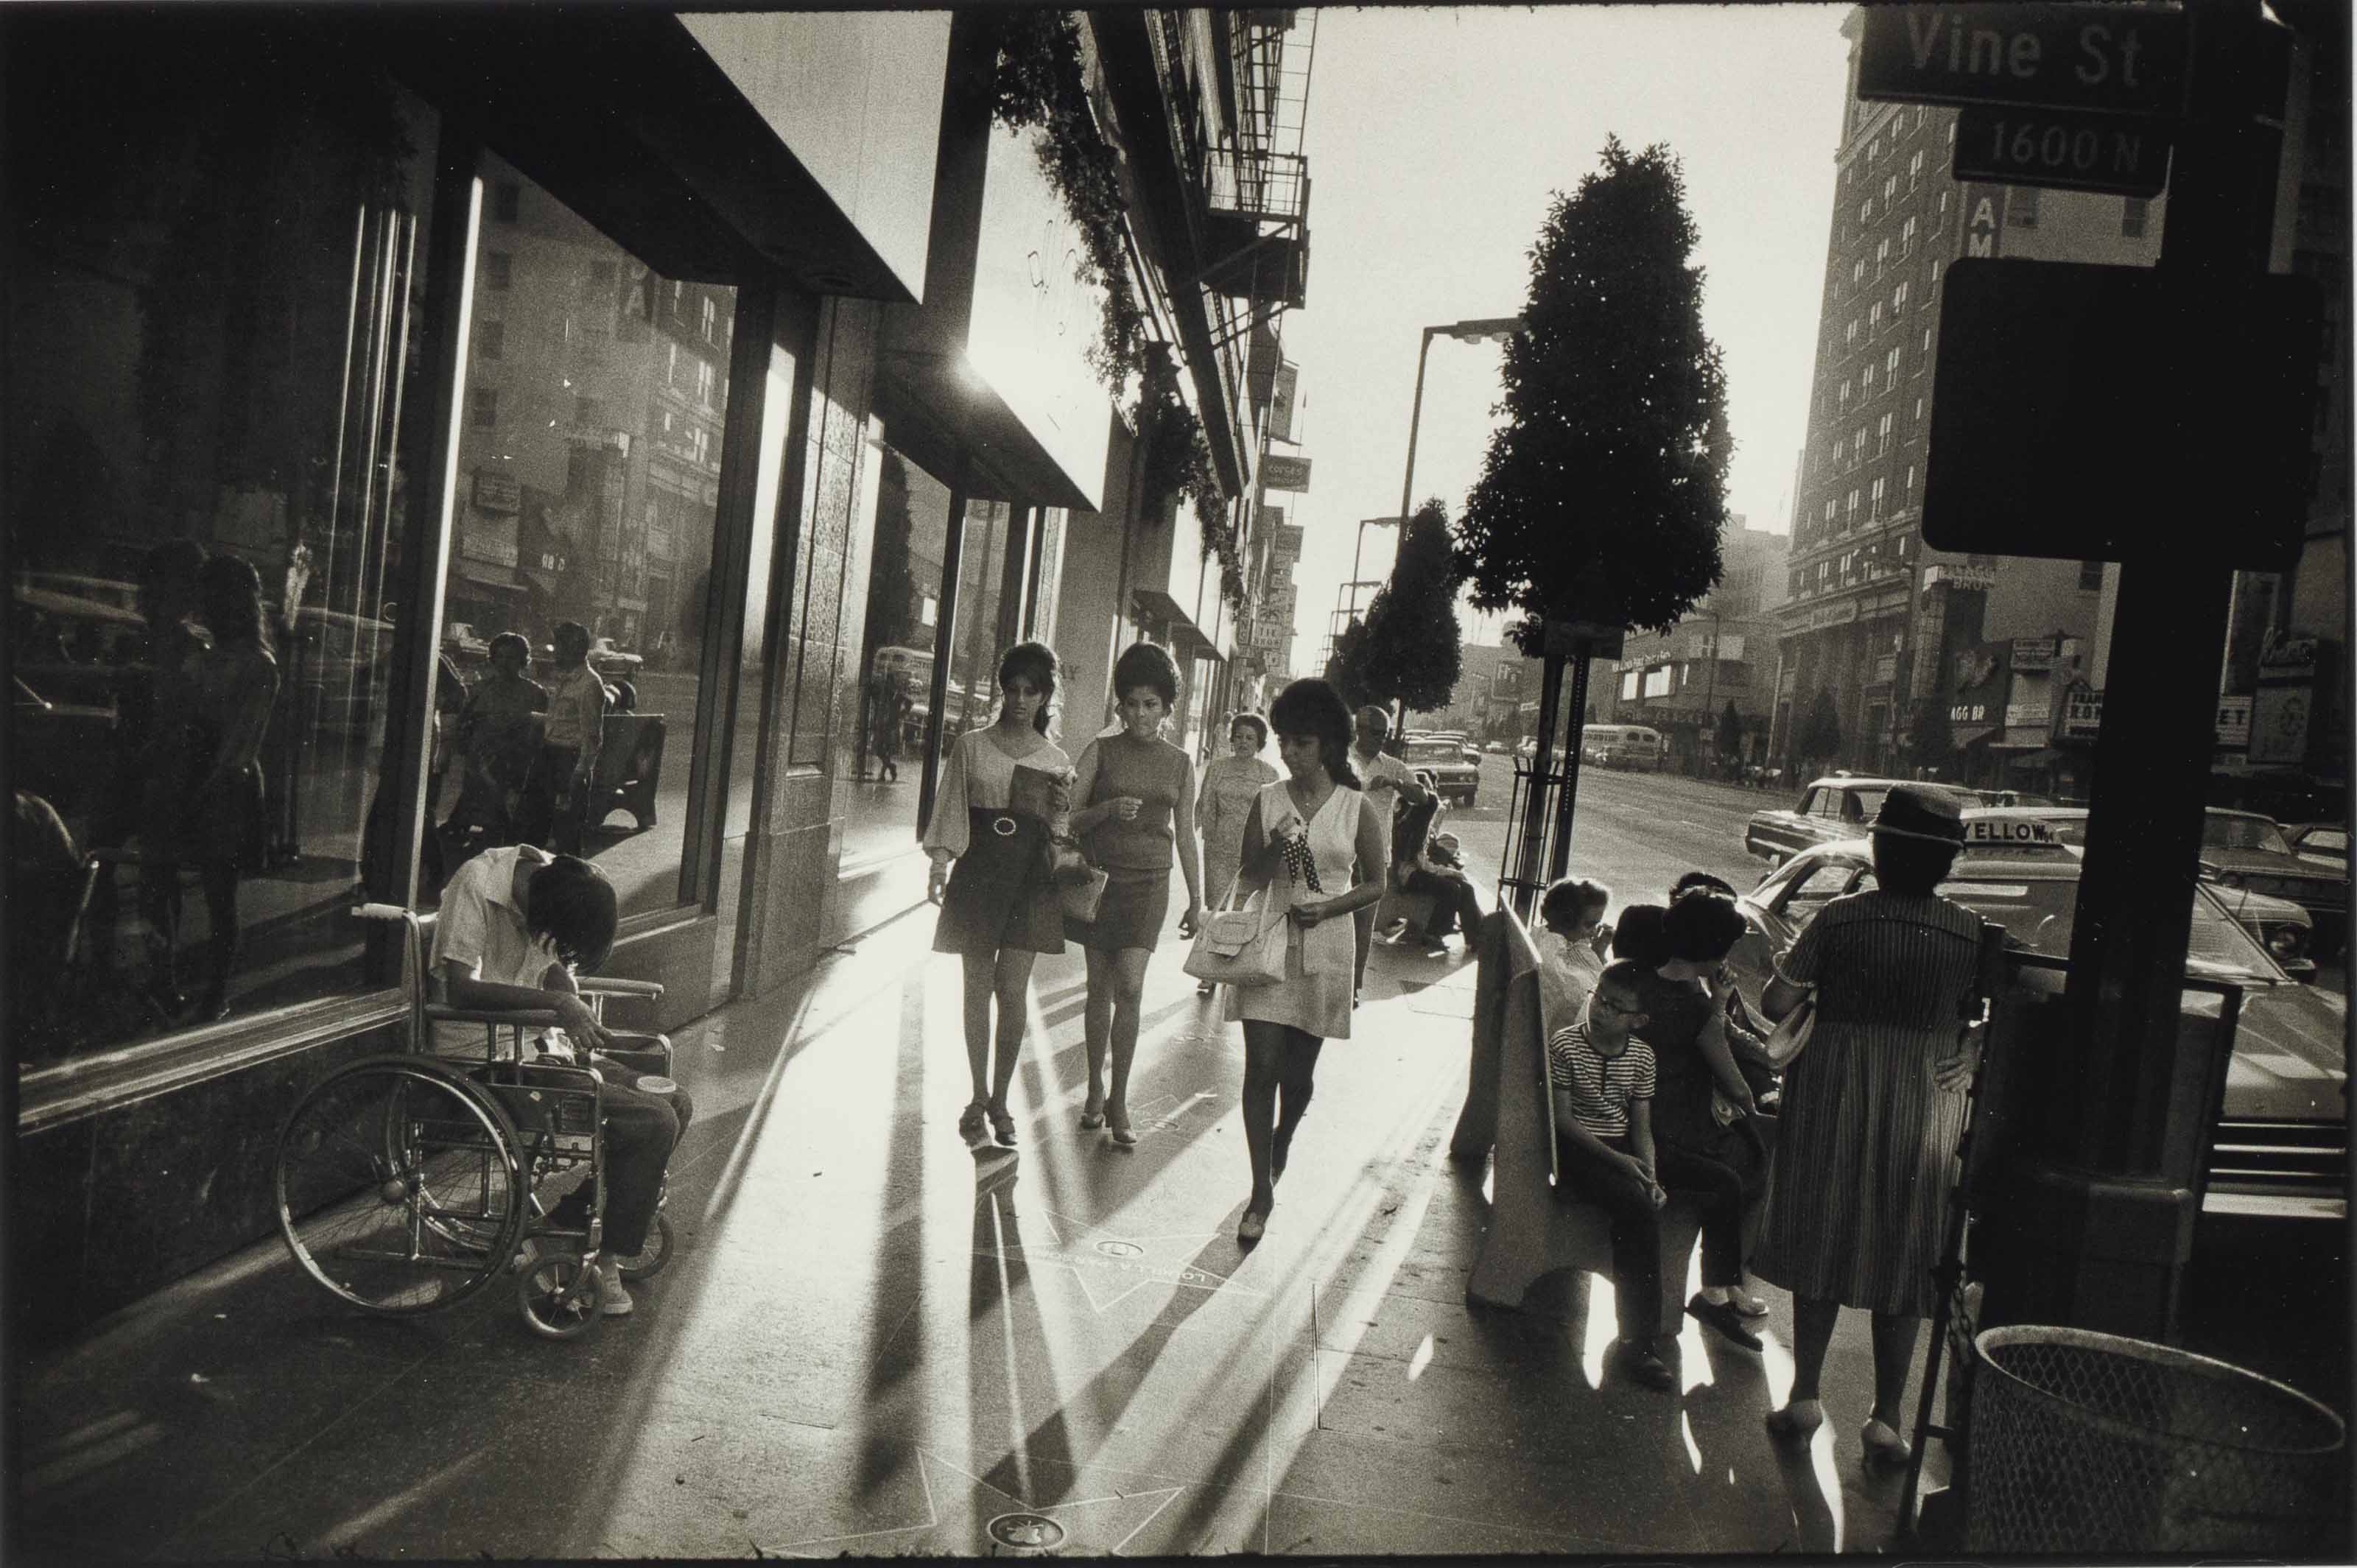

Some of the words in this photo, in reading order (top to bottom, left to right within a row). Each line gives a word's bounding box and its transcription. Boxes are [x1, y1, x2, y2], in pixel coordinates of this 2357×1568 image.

[1906, 10, 2042, 77] Vine
[2074, 24, 2143, 86] St
[1991, 122, 2098, 169] 1600
[2113, 133, 2143, 172] N
[1950, 705, 1968, 721] AGG
[1971, 704, 1984, 721] BR
[2219, 709, 2247, 725] ET
[1961, 822, 2045, 841] YELLOW
